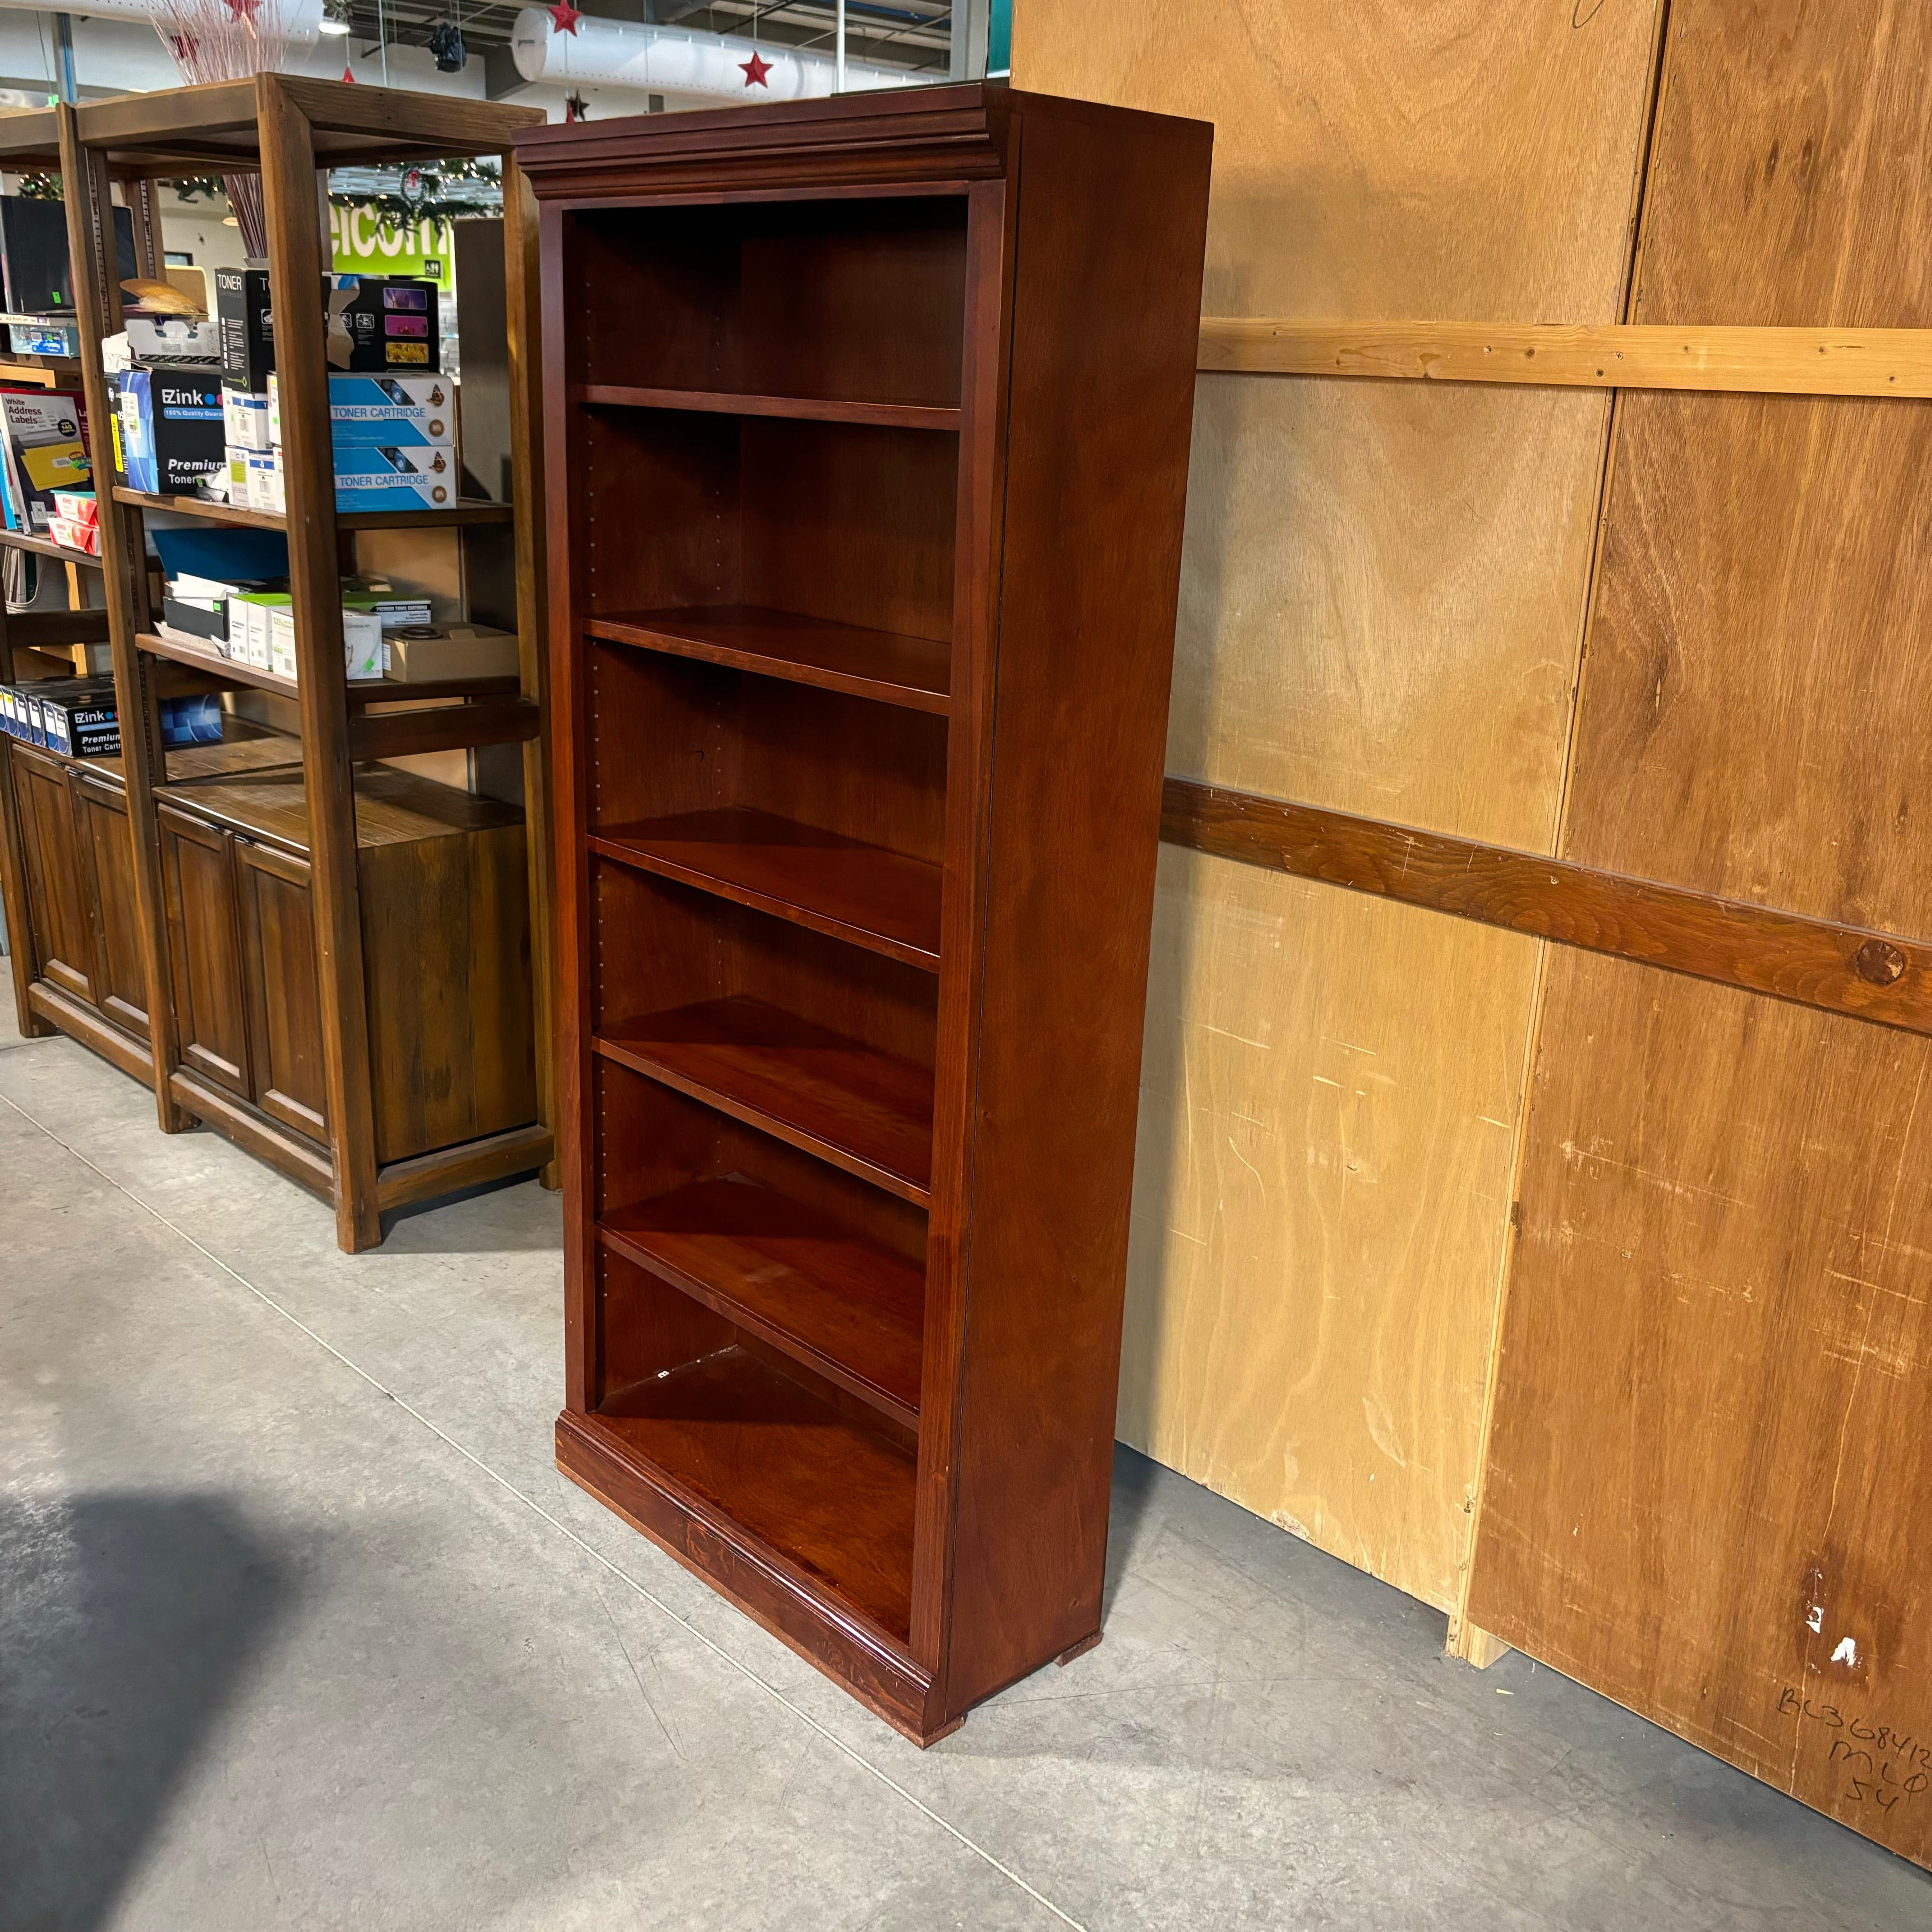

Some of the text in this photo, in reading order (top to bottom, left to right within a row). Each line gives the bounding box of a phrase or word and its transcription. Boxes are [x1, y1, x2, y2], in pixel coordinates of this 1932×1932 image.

[217, 274, 242, 291] TONER
[162, 389, 203, 405] EZink
[9, 406, 42, 415] Address
[333, 408, 425, 417] TONER CARTRIDGE
[10, 415, 38, 424] Labels
[169, 474, 197, 484] Toner
[340, 475, 428, 487] TONER CARTRIDGE
[74, 710, 105, 723] EZink
